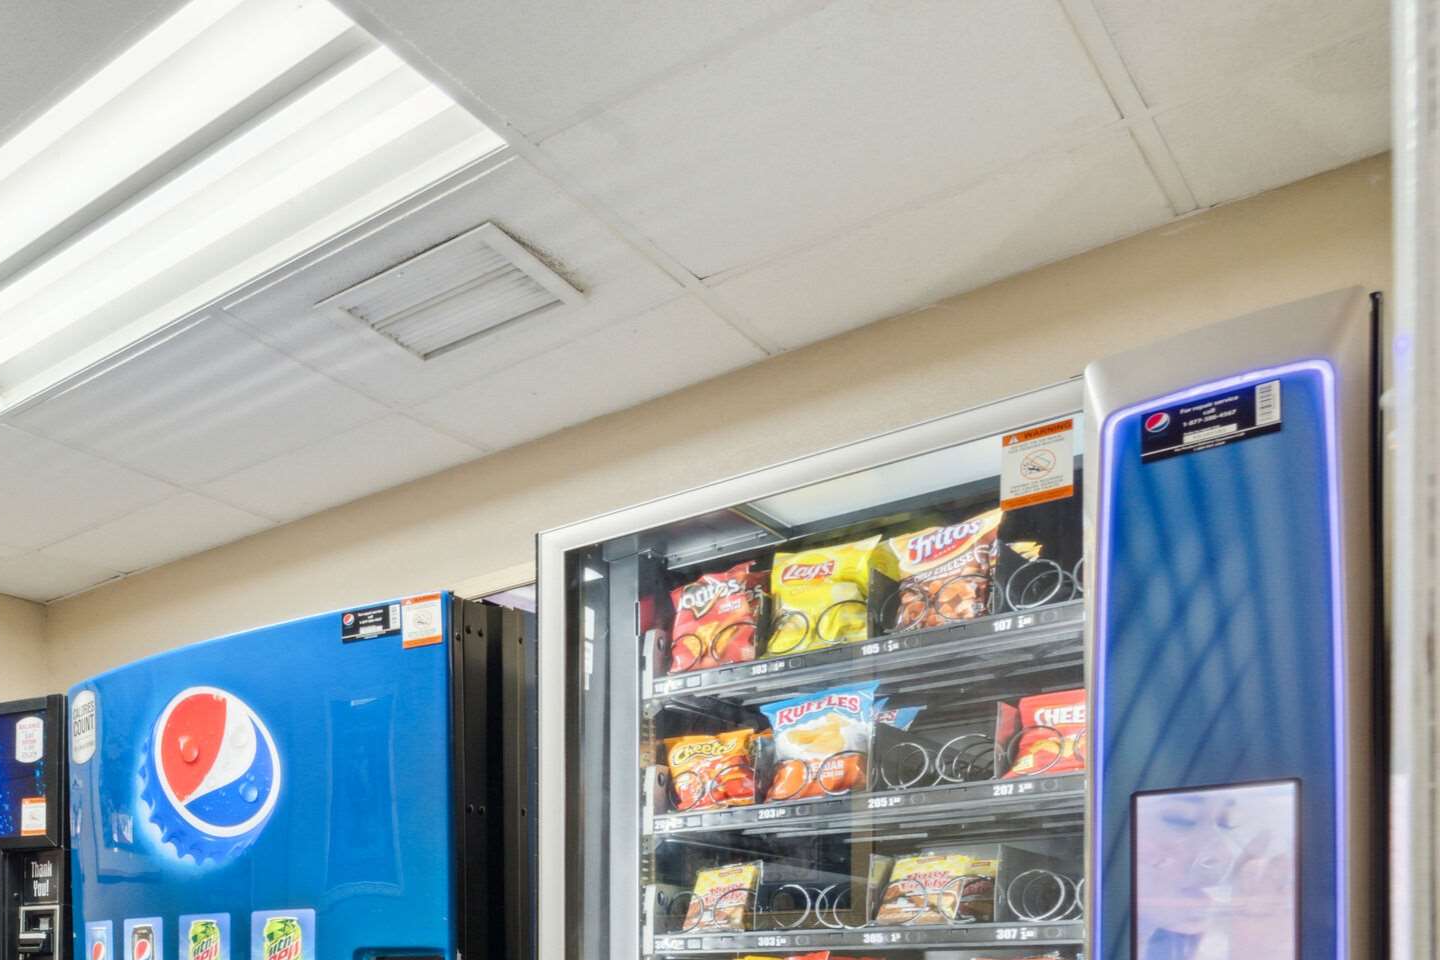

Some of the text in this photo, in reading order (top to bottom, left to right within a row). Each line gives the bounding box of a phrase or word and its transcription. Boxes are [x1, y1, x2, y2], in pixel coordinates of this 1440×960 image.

[908, 519, 981, 565] Fritos
[992, 618, 1012, 632] 107
[861, 643, 880, 656] 105
[777, 694, 861, 727] RUFFLES
[73, 713, 95, 736] COUNT
[993, 785, 1013, 796] 207
[867, 797, 888, 809] 205
[758, 811, 775, 820] 203
[31, 860, 53, 878] Thank
[33, 880, 49, 897] You!
[863, 933, 885, 944] 305
[996, 928, 1017, 940] 307
[758, 936, 775, 947] 303
